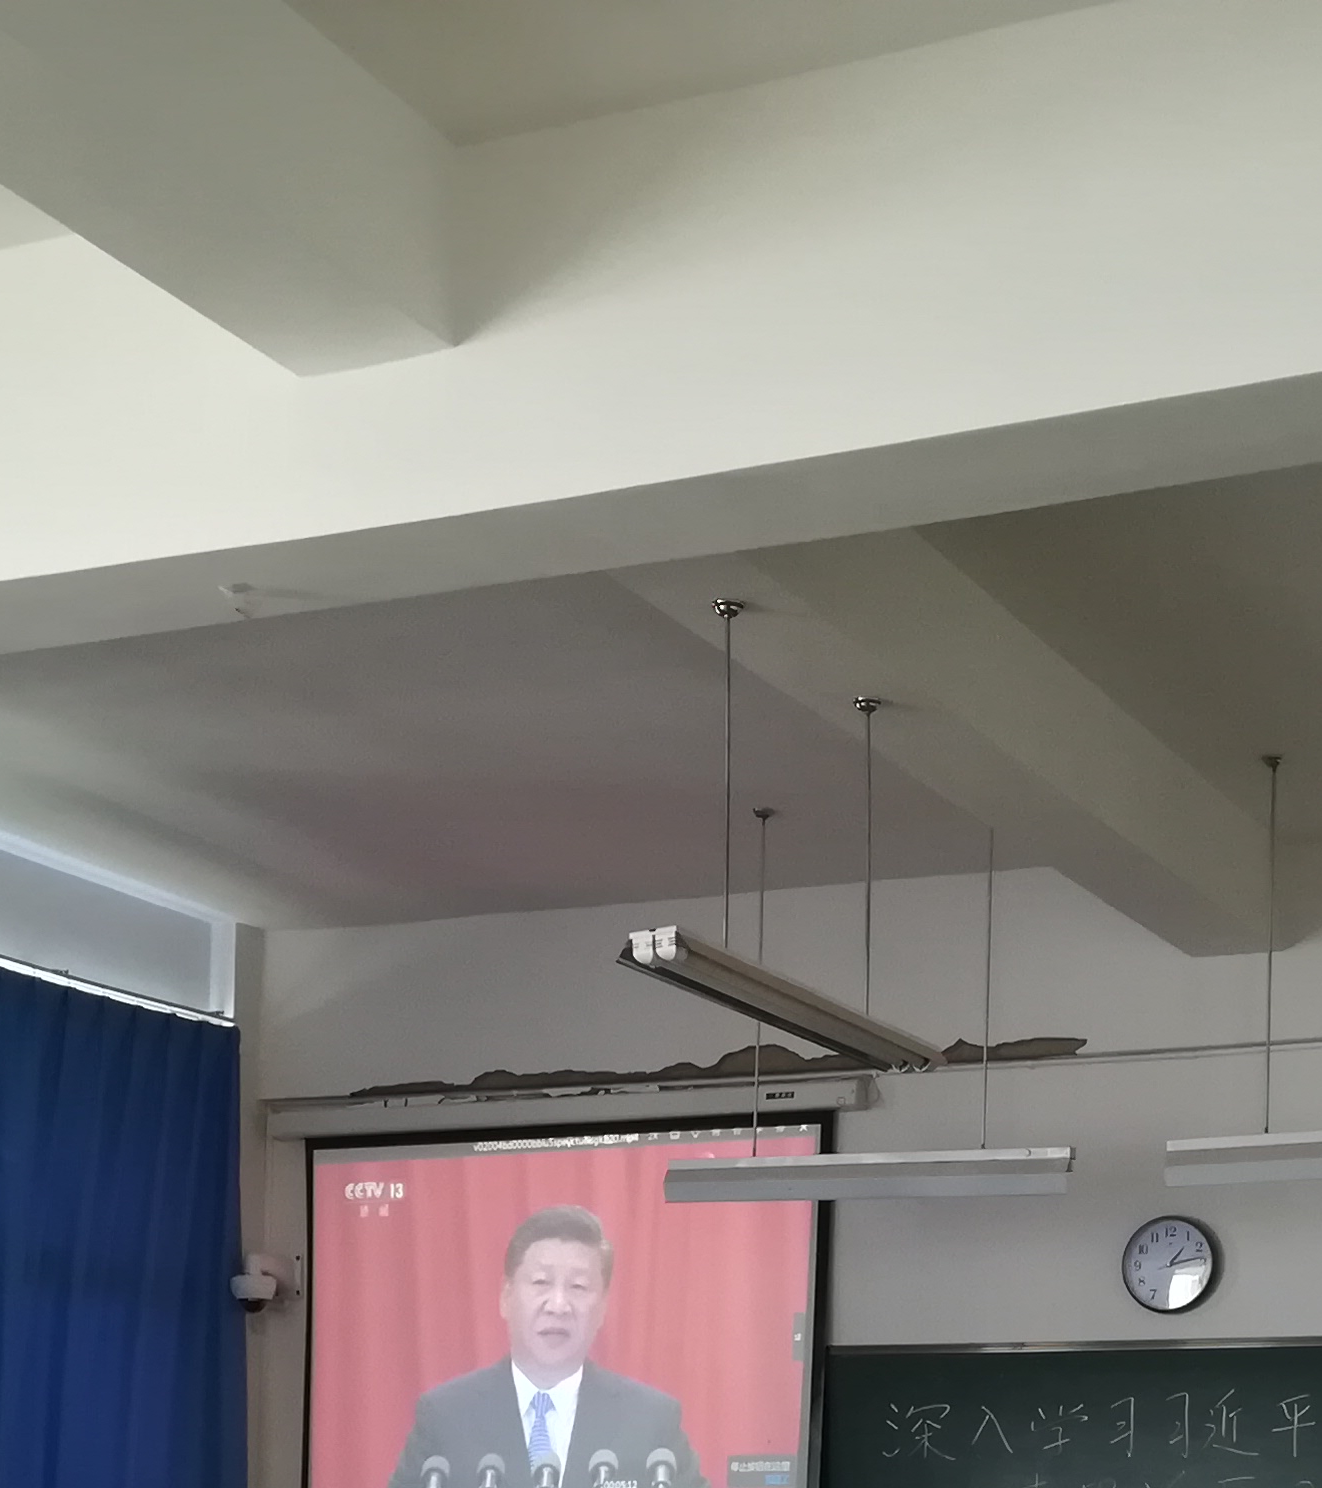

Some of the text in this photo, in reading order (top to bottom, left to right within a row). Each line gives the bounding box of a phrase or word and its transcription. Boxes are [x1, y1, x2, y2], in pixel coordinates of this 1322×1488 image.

[344, 1182, 404, 1200] CCTV 13
[1150, 1232, 1159, 1243] 11
[1164, 1226, 1177, 1238] 12
[1138, 1244, 1149, 1255] 10
[1195, 1241, 1204, 1252] 2
[1134, 1260, 1141, 1271] 9
[1138, 1277, 1146, 1286] 8
[1149, 1289, 1157, 1300] 7
